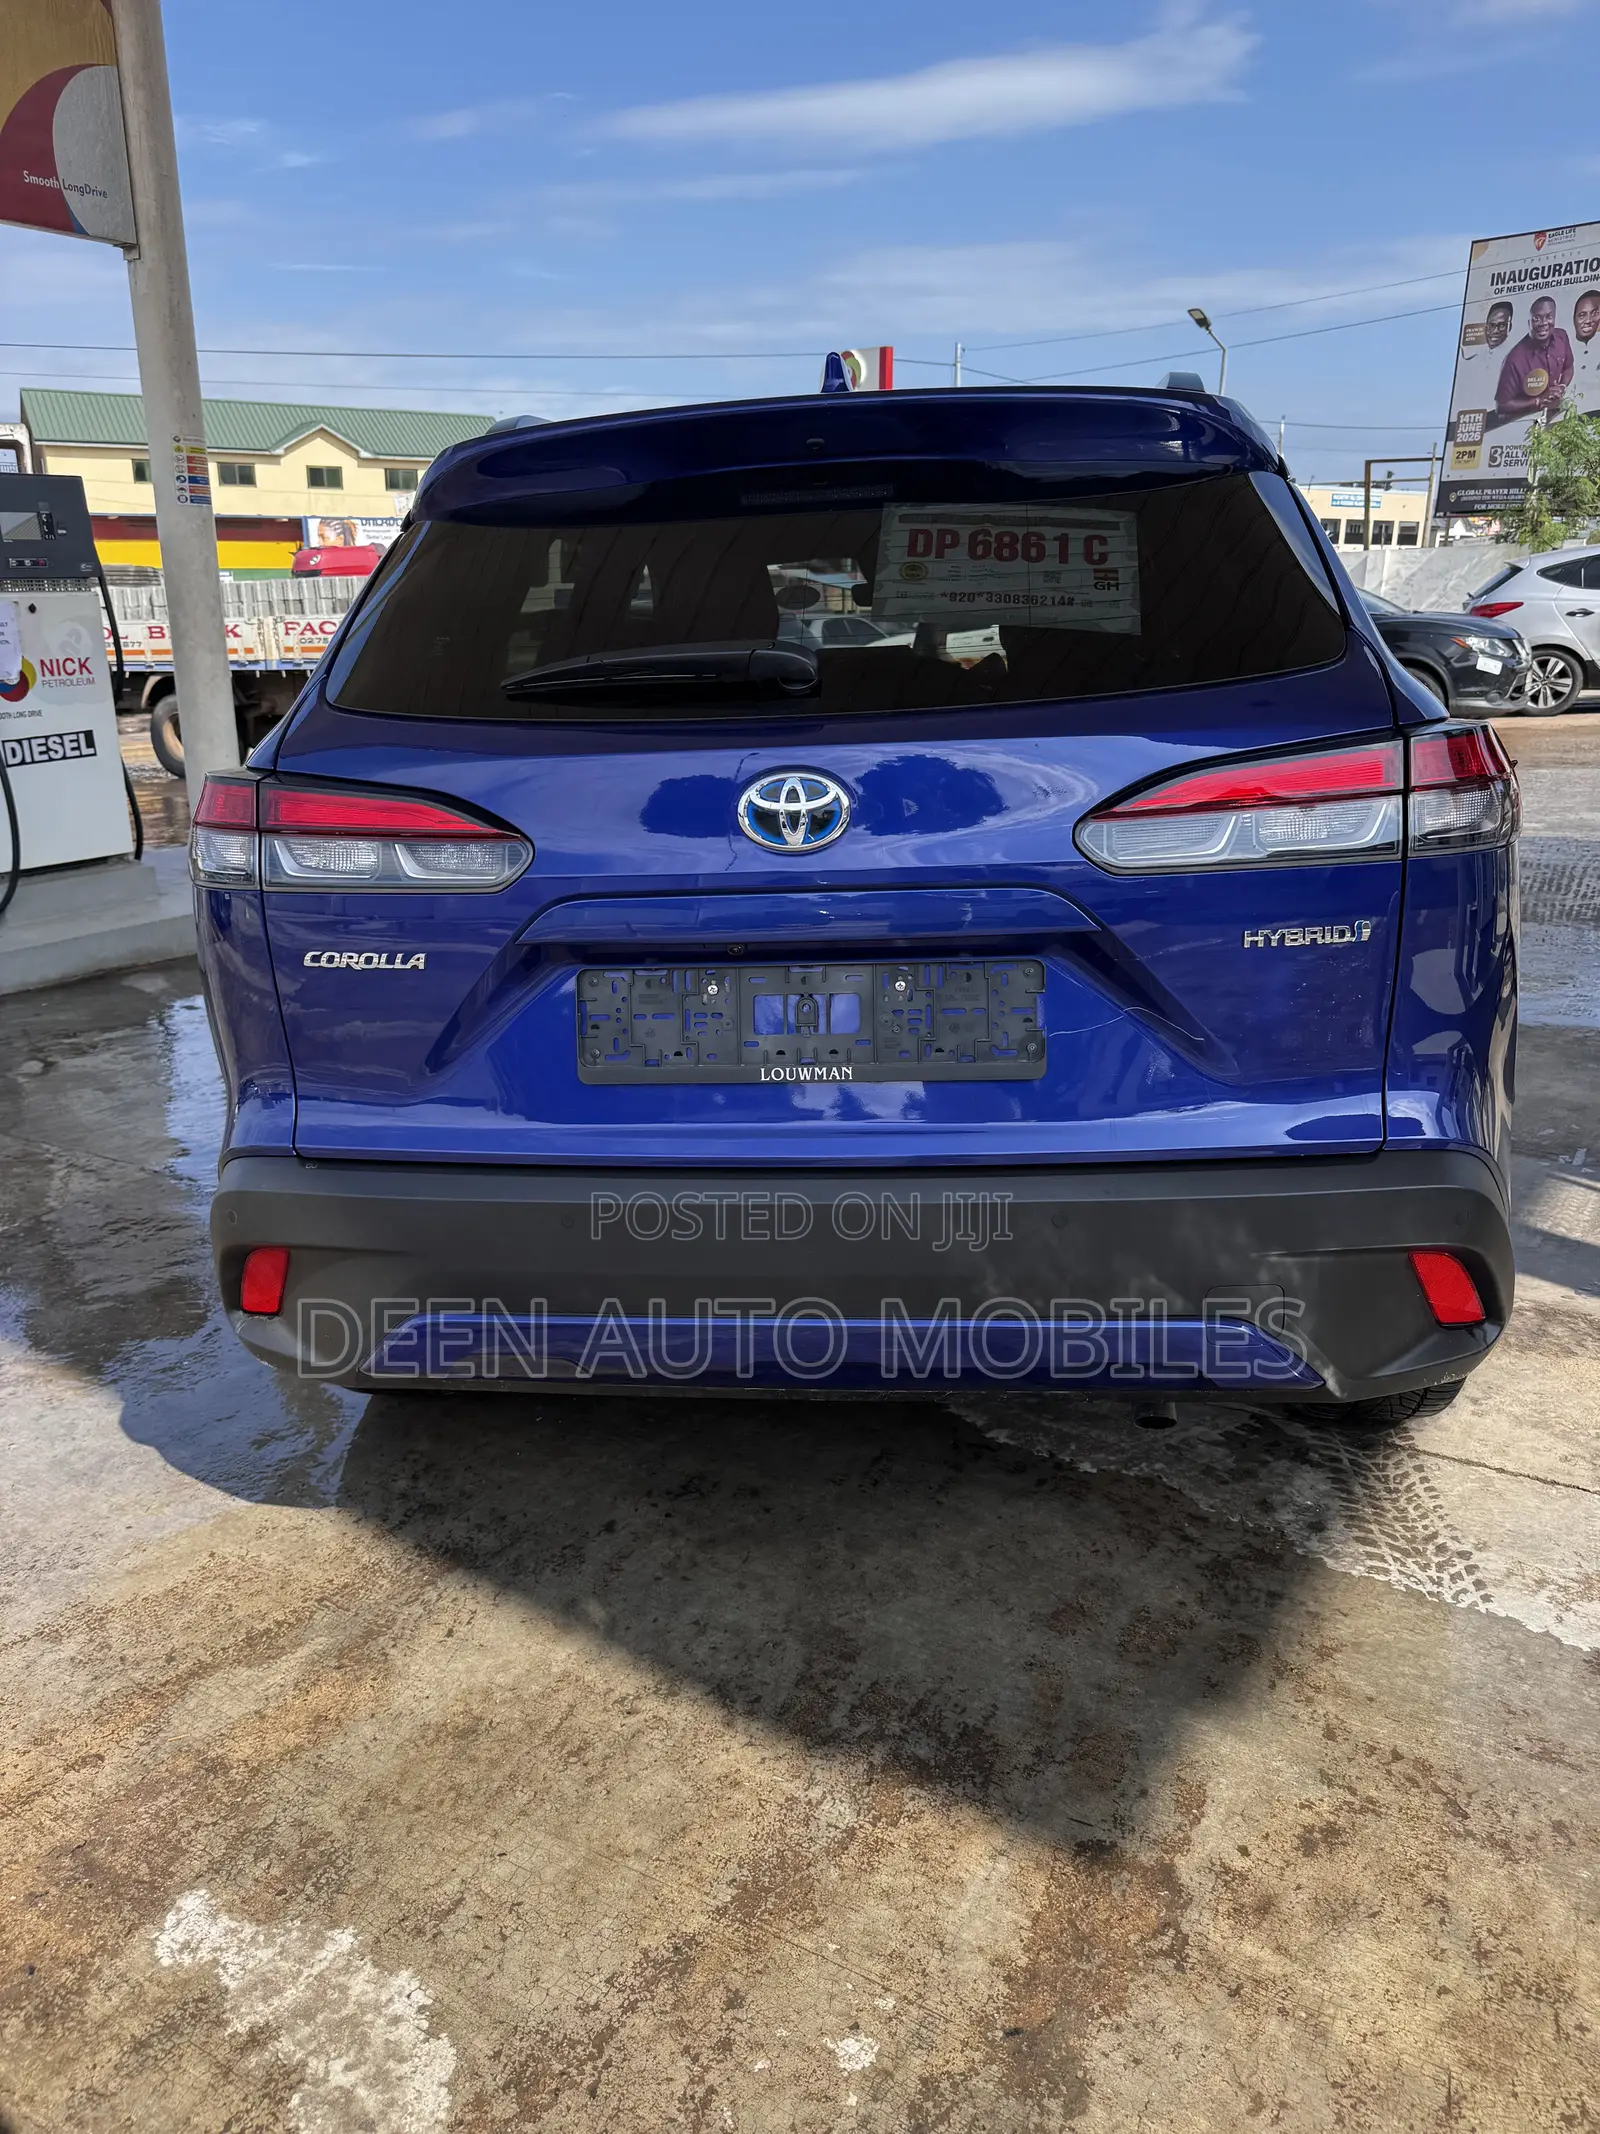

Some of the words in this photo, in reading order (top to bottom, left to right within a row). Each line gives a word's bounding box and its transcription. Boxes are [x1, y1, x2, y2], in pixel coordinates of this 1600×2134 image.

[23, 170, 60, 189] Smooth
[61, 178, 108, 199] LongDrive
[1494, 286, 1506, 295] OF
[1506, 284, 1526, 293] NEW
[1526, 279, 1562, 291] CHURCH
[1460, 413, 1483, 423] 14TH
[1457, 423, 1483, 433] JUNE
[1456, 432, 1481, 442] 2026
[1455, 450, 1476, 459] 2PM
[1503, 459, 1528, 467] SERVI
[907, 528, 960, 559] DP
[968, 528, 1069, 564] 6861
[1083, 534, 1108, 565] C
[1093, 581, 1120, 591] GH
[283, 621, 337, 635] FAC
[40, 657, 93, 677] NICK
[42, 677, 96, 688] PETROLEUM
[4, 732, 95, 766] DIESEL
[1244, 925, 1351, 948] HYBRID
[303, 951, 427, 970] COROLLA
[760, 1066, 853, 1081] LOUWMAN
